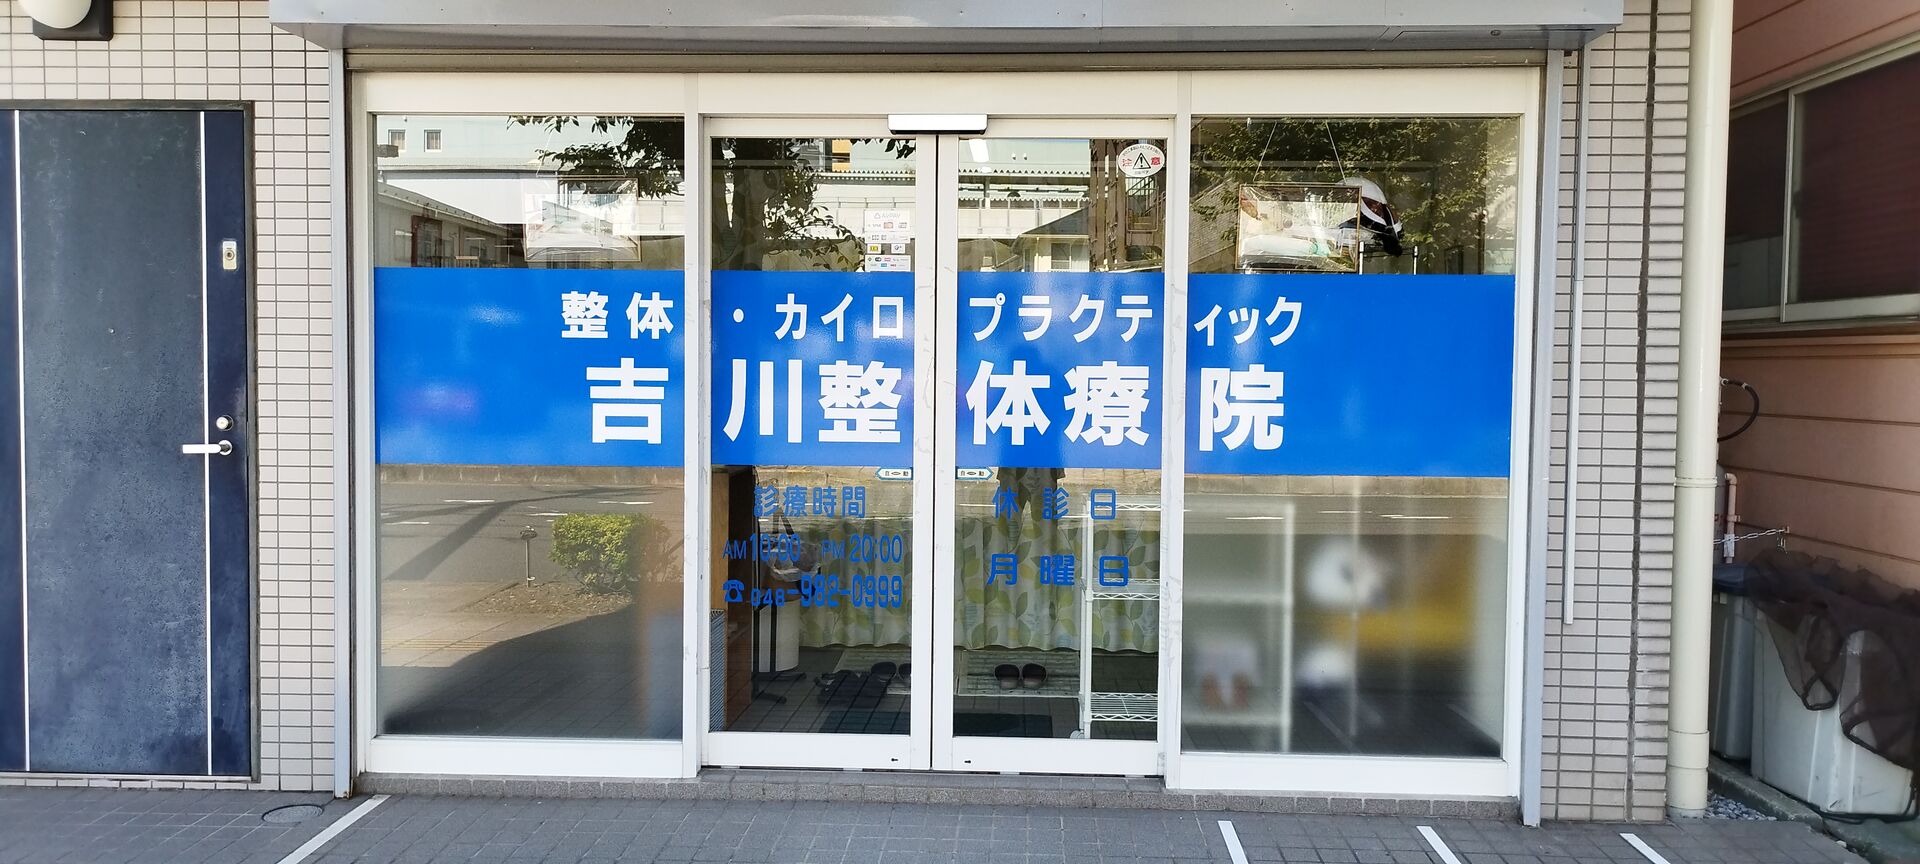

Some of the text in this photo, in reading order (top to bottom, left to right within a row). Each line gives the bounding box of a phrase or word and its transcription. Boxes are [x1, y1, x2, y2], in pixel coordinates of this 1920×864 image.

[753, 484, 866, 518] 診療時間
[992, 486, 1117, 520] 休診日
[987, 553, 1129, 587] 月曜日
